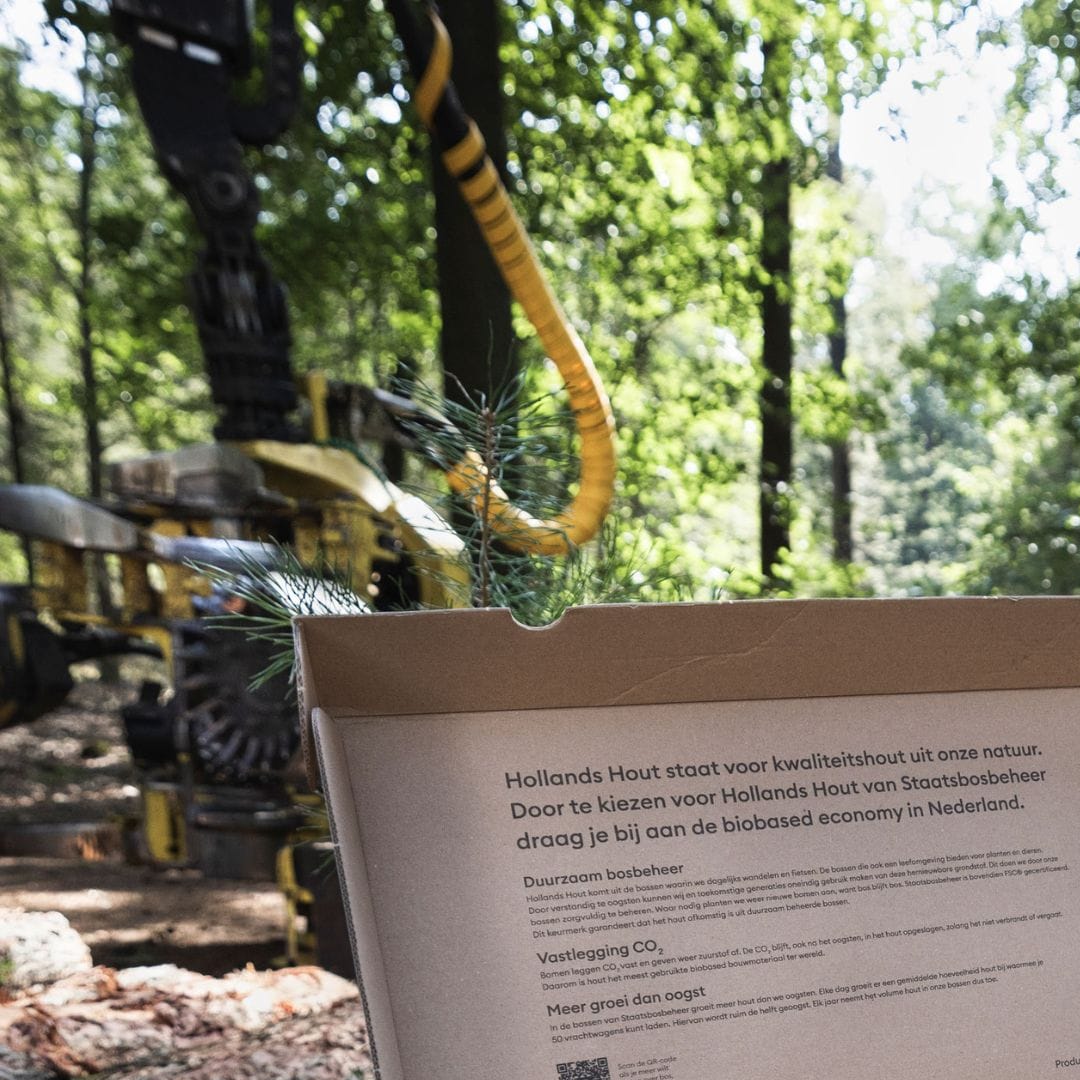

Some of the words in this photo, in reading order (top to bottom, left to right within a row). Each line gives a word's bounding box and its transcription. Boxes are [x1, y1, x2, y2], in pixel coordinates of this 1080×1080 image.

[505, 766, 603, 789] Hollands
[608, 765, 661, 782] Hout
[666, 761, 720, 778] staat
[723, 760, 768, 774] voor
[772, 750, 906, 772] kwaliteitshout
[910, 747, 934, 763] uit
[937, 748, 978, 761] onze
[983, 744, 1042, 758] natuur.
[510, 802, 564, 819] Door
[568, 800, 592, 814] te
[597, 795, 666, 812] kiezen
[670, 793, 716, 807] voor
[721, 782, 808, 804] Hollands
[812, 781, 860, 797] Hout
[861, 780, 897, 793] van
[901, 768, 1046, 790] Staatsbosbeheer
[516, 832, 584, 850] draag
[588, 826, 608, 848] je
[614, 823, 640, 844] bij
[646, 824, 686, 839] aan
[692, 818, 717, 835] de
[722, 810, 813, 832] biobased
[818, 807, 903, 825] economy
[907, 802, 924, 817] in
[928, 794, 1024, 816] Nederland.
[523, 872, 602, 888] Duurzaam
[606, 864, 684, 880] bosbeheer
[525, 892, 564, 902] Hollands
[587, 888, 609, 896] komt
[610, 886, 621, 894] uit
[635, 884, 664, 892] bossen
[706, 875, 741, 885] dagelijks
[741, 872, 779, 881] wandelen
[528, 906, 549, 914] Door
[550, 901, 595, 912] verstandig
[607, 897, 641, 906] oogsten
[641, 894, 672, 902] kunnen
[697, 887, 744, 897] toekomstige
[745, 882, 786, 893] generaties
[787, 878, 819, 888] oneindig
[820, 875, 848, 886] gebruik
[529, 917, 560, 926] bossen
[562, 911, 606, 922] zorgvuldig
[678, 901, 701, 910] nodig
[702, 899, 732, 909] planten
[765, 893, 792, 901] nieuwe
[532, 930, 545, 939] Dit
[546, 925, 587, 936] keurmerk
[587, 921, 636, 934] garandeert
[636, 919, 651, 927] dat
[652, 917, 666, 925] het
[667, 915, 686, 923] hout
[687, 911, 726, 921] afkomstig
[746, 905, 785, 915] duurzaam
[785, 900, 821, 911] beheerde
[536, 944, 629, 964] Vastlegging
[539, 970, 570, 979] Bomen
[571, 966, 601, 976] leggen
[619, 961, 637, 969] vast
[651, 957, 676, 967] geven
[677, 954, 697, 962] weer
[698, 949, 729, 959] zuurstof
[541, 981, 577, 991] Daarom
[578, 978, 585, 986] is
[586, 976, 606, 985] hout
[607, 974, 622, 982] het
[623, 971, 648, 980] meest
[649, 967, 688, 979] gebruikte
[689, 961, 726, 972] biobased
[727, 954, 785, 967] bouwmateriaal
[546, 1002, 586, 1017] Meer
[590, 994, 628, 1014] groei
[632, 992, 661, 1005] dan
[665, 986, 706, 1002] oogst
[559, 1022, 571, 1030] de
[572, 1019, 602, 1028] bossen
[620, 1007, 689, 1022] Staatsbosbeheer
[690, 1003, 714, 1013] groeit
[736, 998, 755, 1006] hout
[551, 1035, 563, 1043] 50
[563, 1028, 624, 1041] vrachtwagens
[624, 1024, 644, 1033] kunt
[672, 1017, 704, 1026] Hiervan
[704, 1013, 728, 1022] wordt
[729, 1010, 747, 1018] ruim
[747, 1008, 758, 1016] de
[759, 1005, 778, 1014] helft
